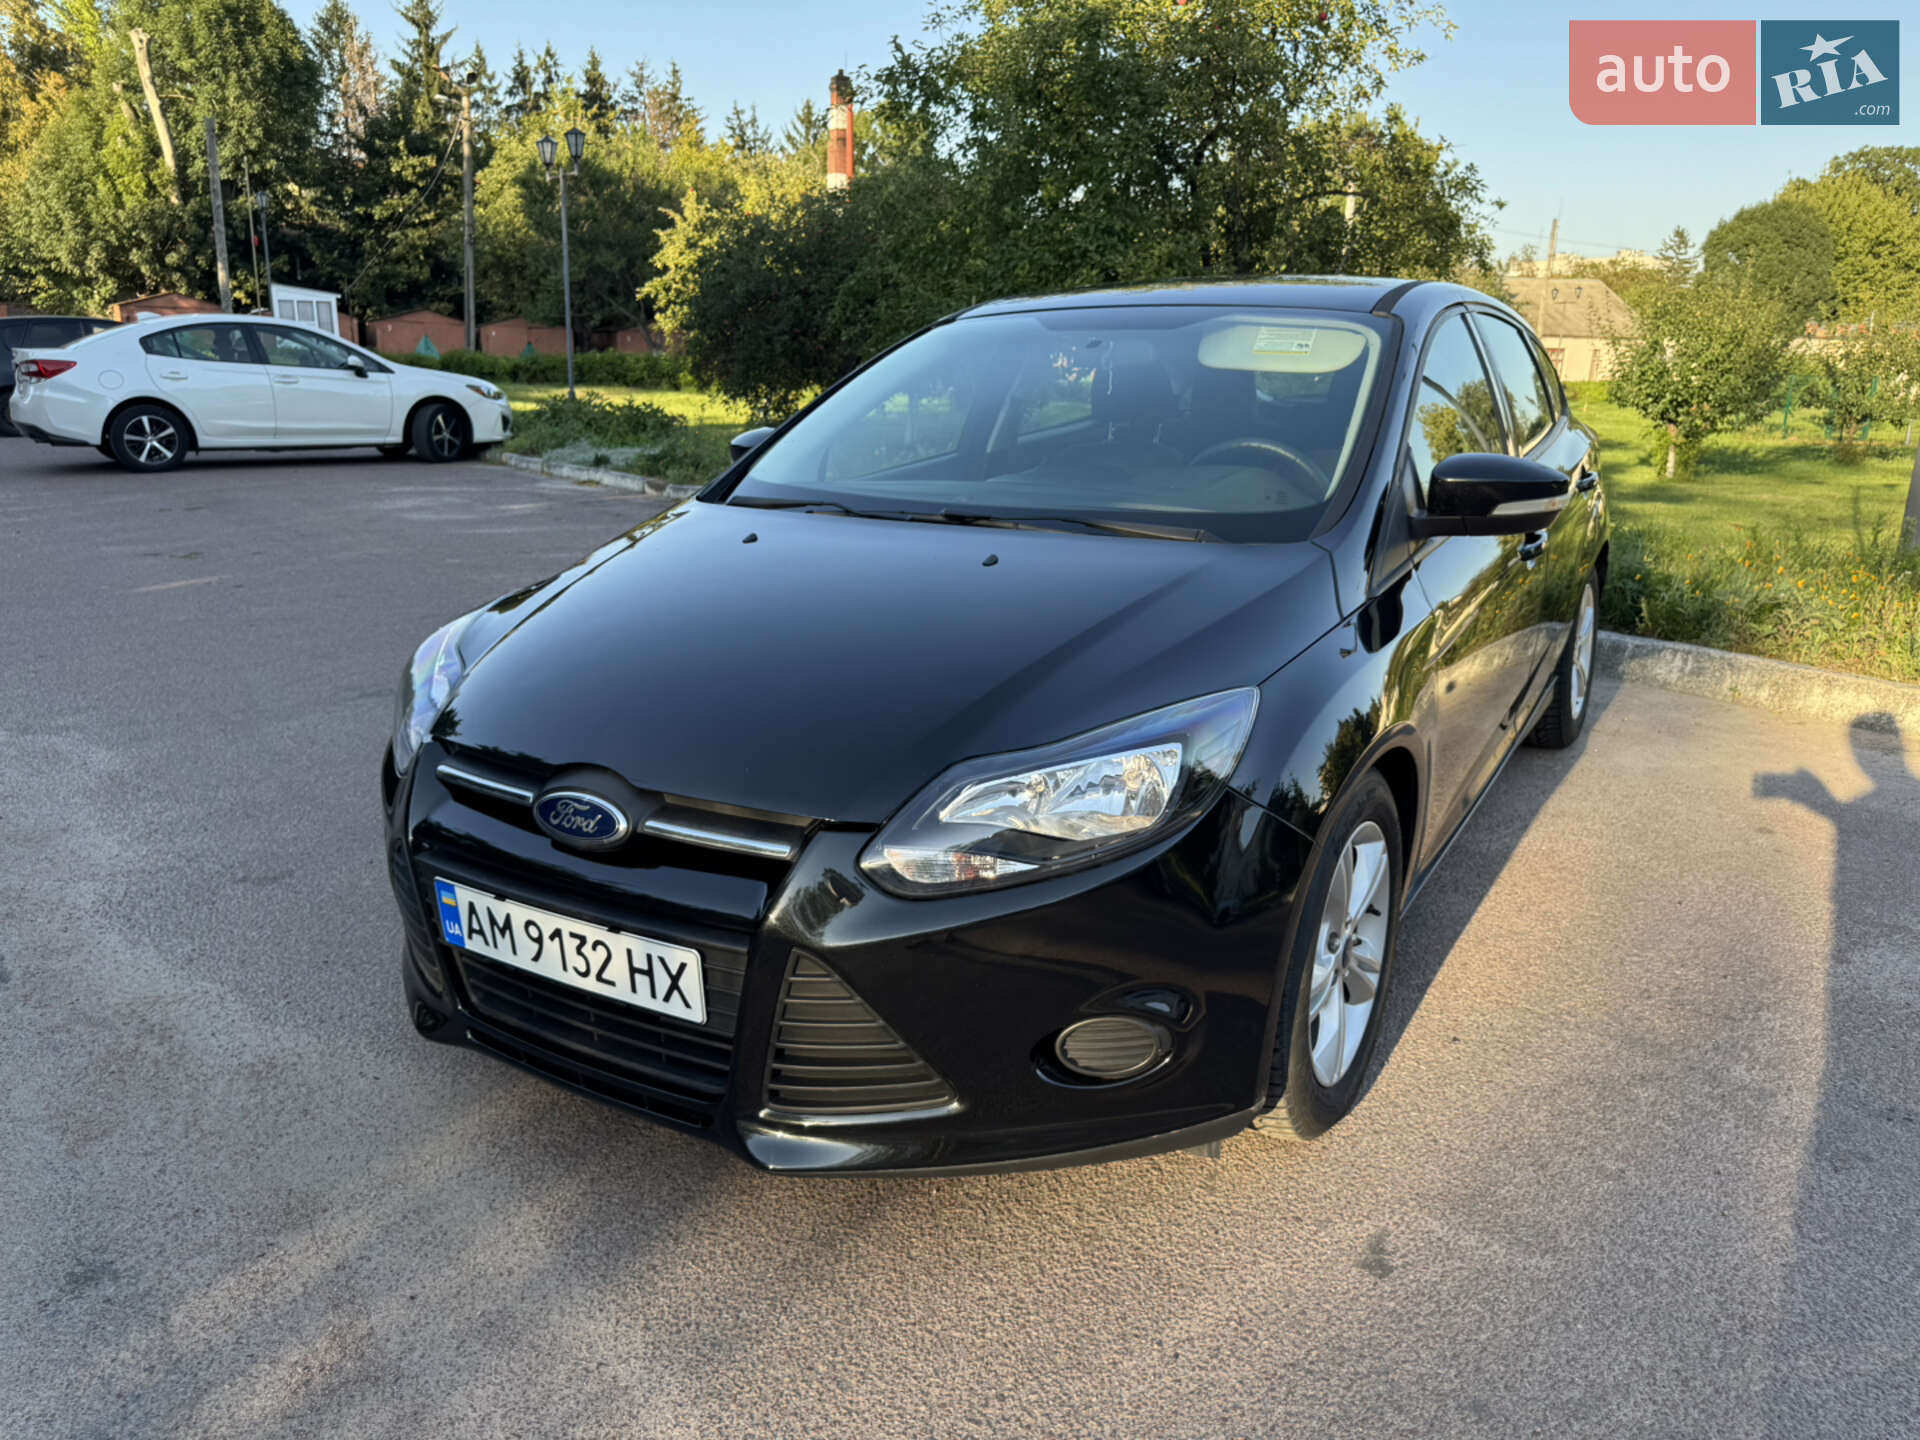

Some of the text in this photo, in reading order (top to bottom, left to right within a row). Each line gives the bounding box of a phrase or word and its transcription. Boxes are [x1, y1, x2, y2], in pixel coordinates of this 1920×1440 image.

[550, 799, 603, 834] Ford
[446, 920, 463, 937] UA
[467, 901, 692, 1009] AM 9132 HX
